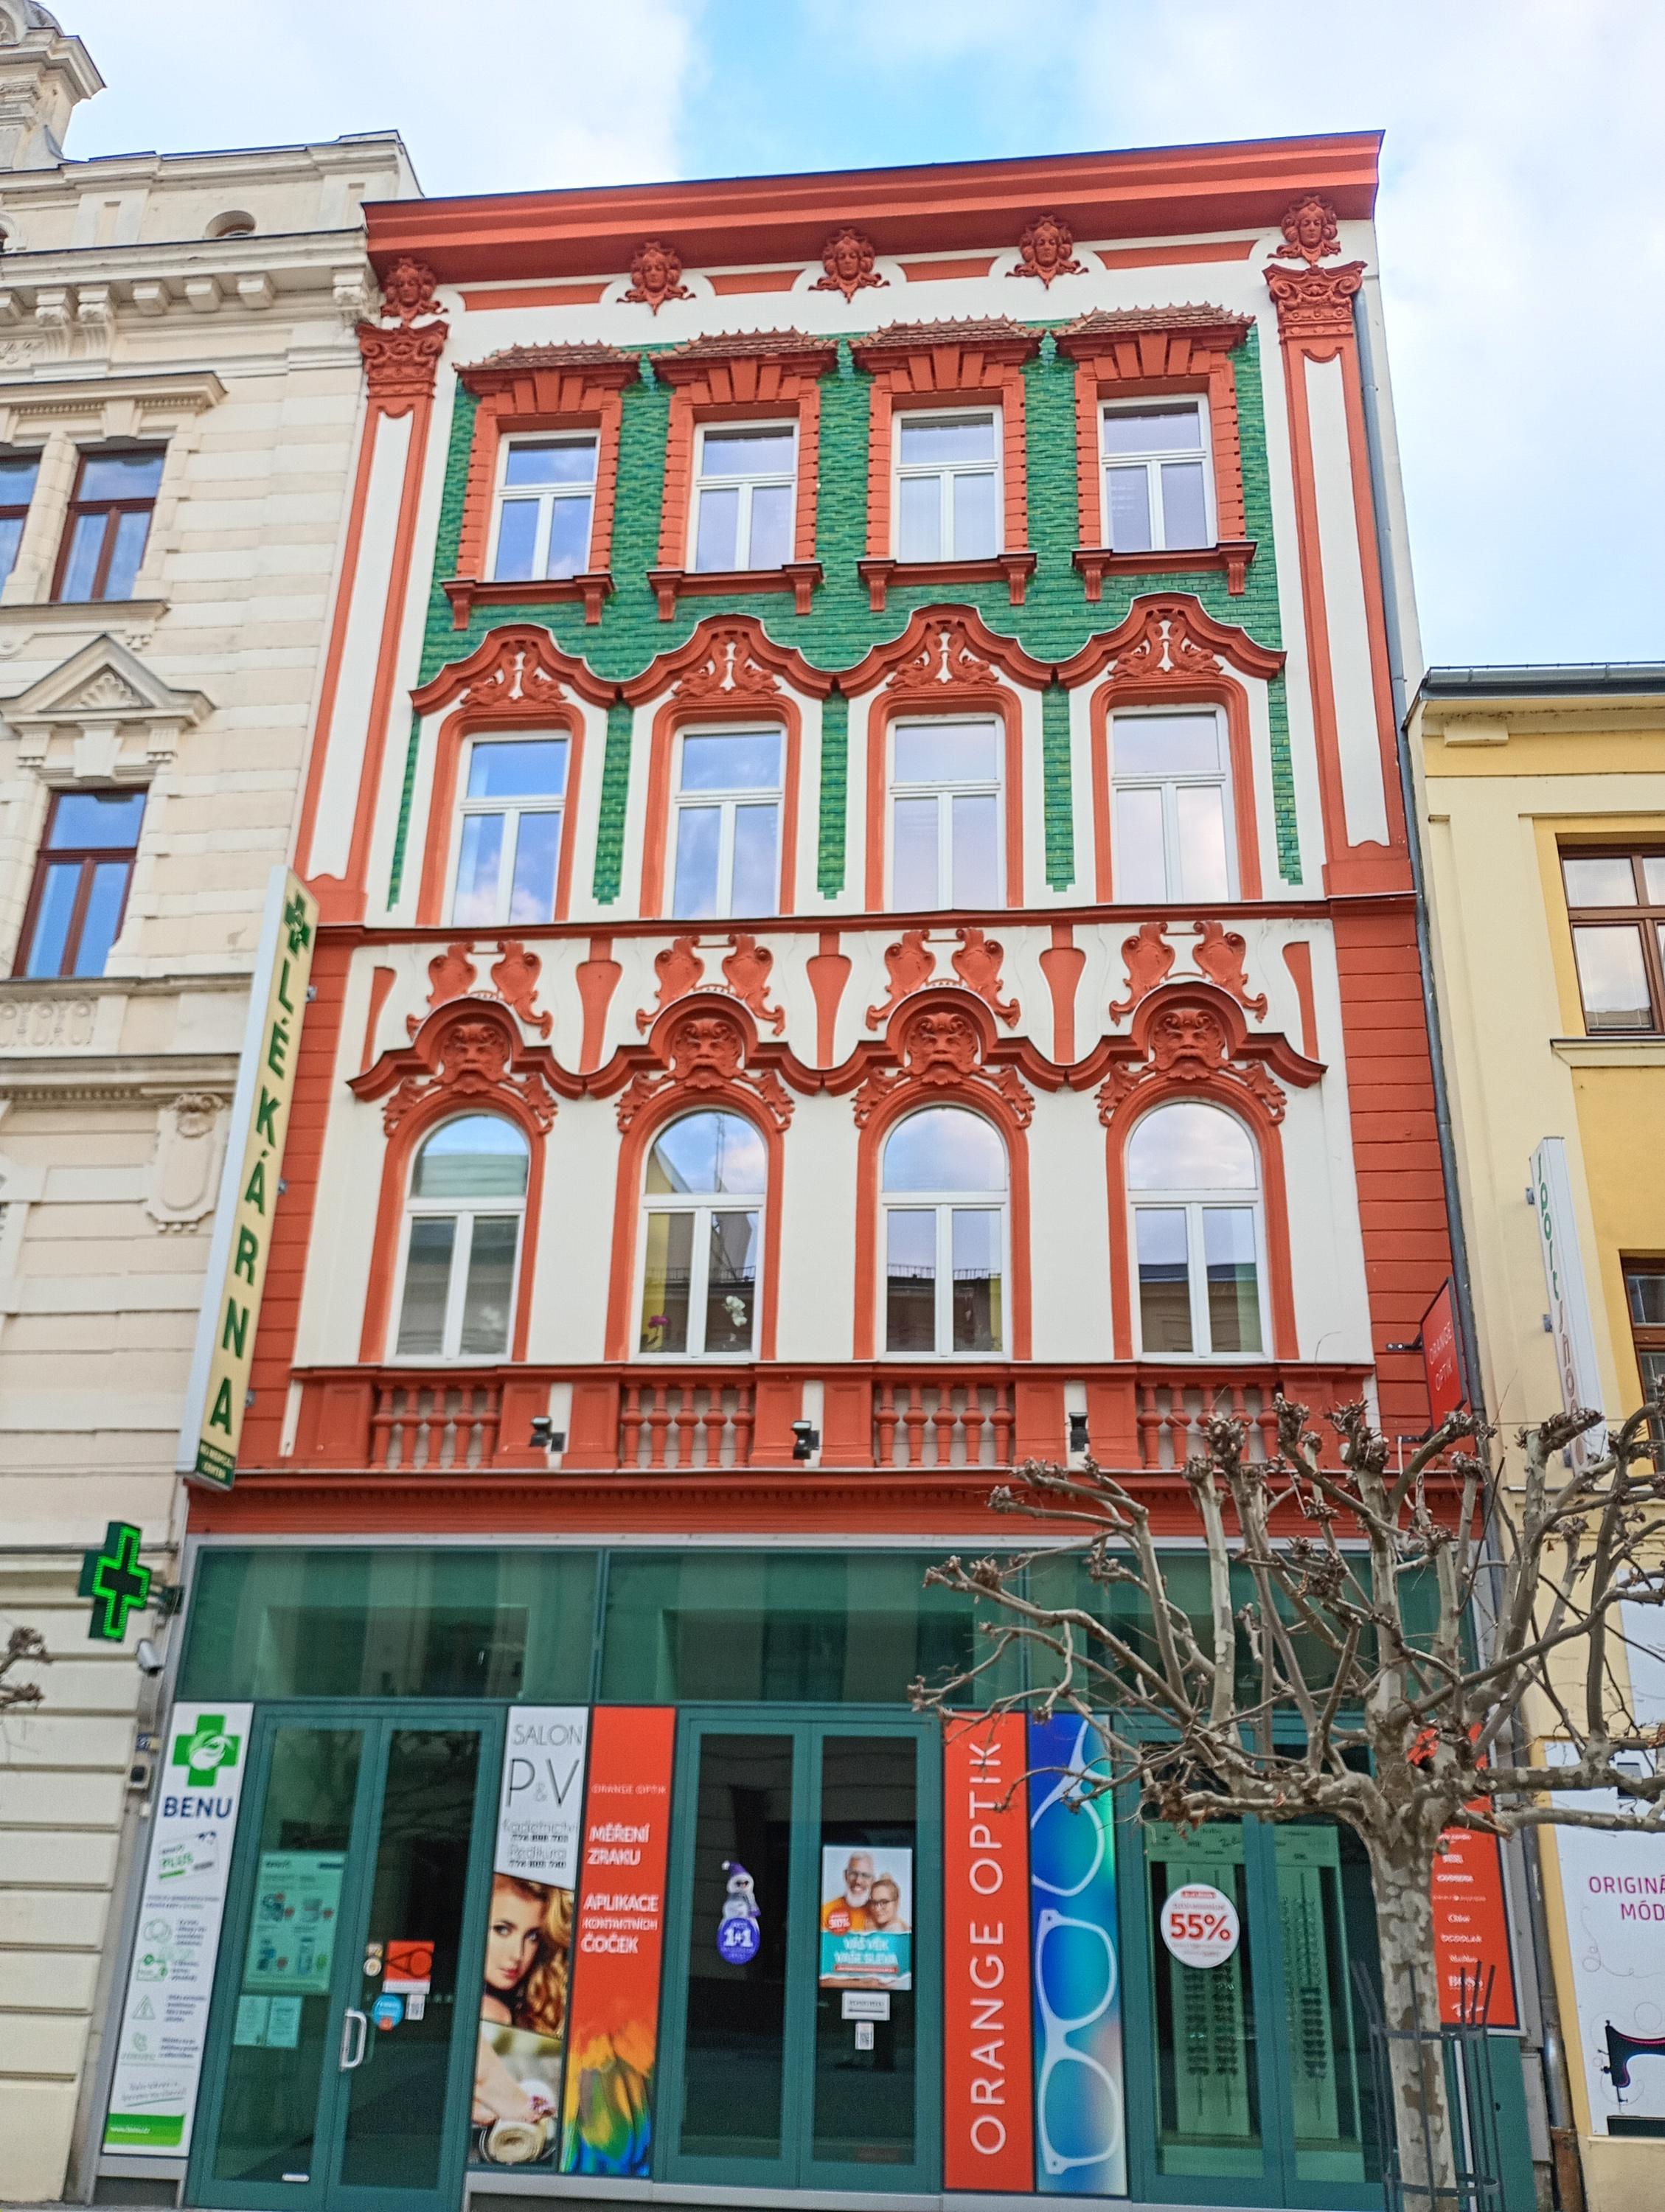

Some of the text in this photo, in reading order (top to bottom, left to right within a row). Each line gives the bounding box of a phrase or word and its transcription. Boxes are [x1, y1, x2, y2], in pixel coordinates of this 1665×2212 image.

[209, 959, 293, 1436] LÉKÁRNA
[1429, 1321, 1452, 1365] ORANGE
[1435, 1357, 1453, 1391] OPTIK
[513, 1724, 583, 1746] SALON
[591, 1784, 666, 1794] ORANGE OPTIK
[163, 1796, 232, 1818] BENU
[589, 1823, 650, 1843] MĚŘENÍ
[587, 1847, 641, 1865] ZRAKU
[583, 1893, 658, 1912] APLIKACE
[1621, 1900, 1665, 1921] MÓD
[583, 1916, 658, 1930] KONTAKTNÍCH
[1170, 1913, 1231, 1941] 55%
[581, 1930, 639, 1954] ČOČEK
[968, 1742, 1007, 2156] ORANGE OPTIK
